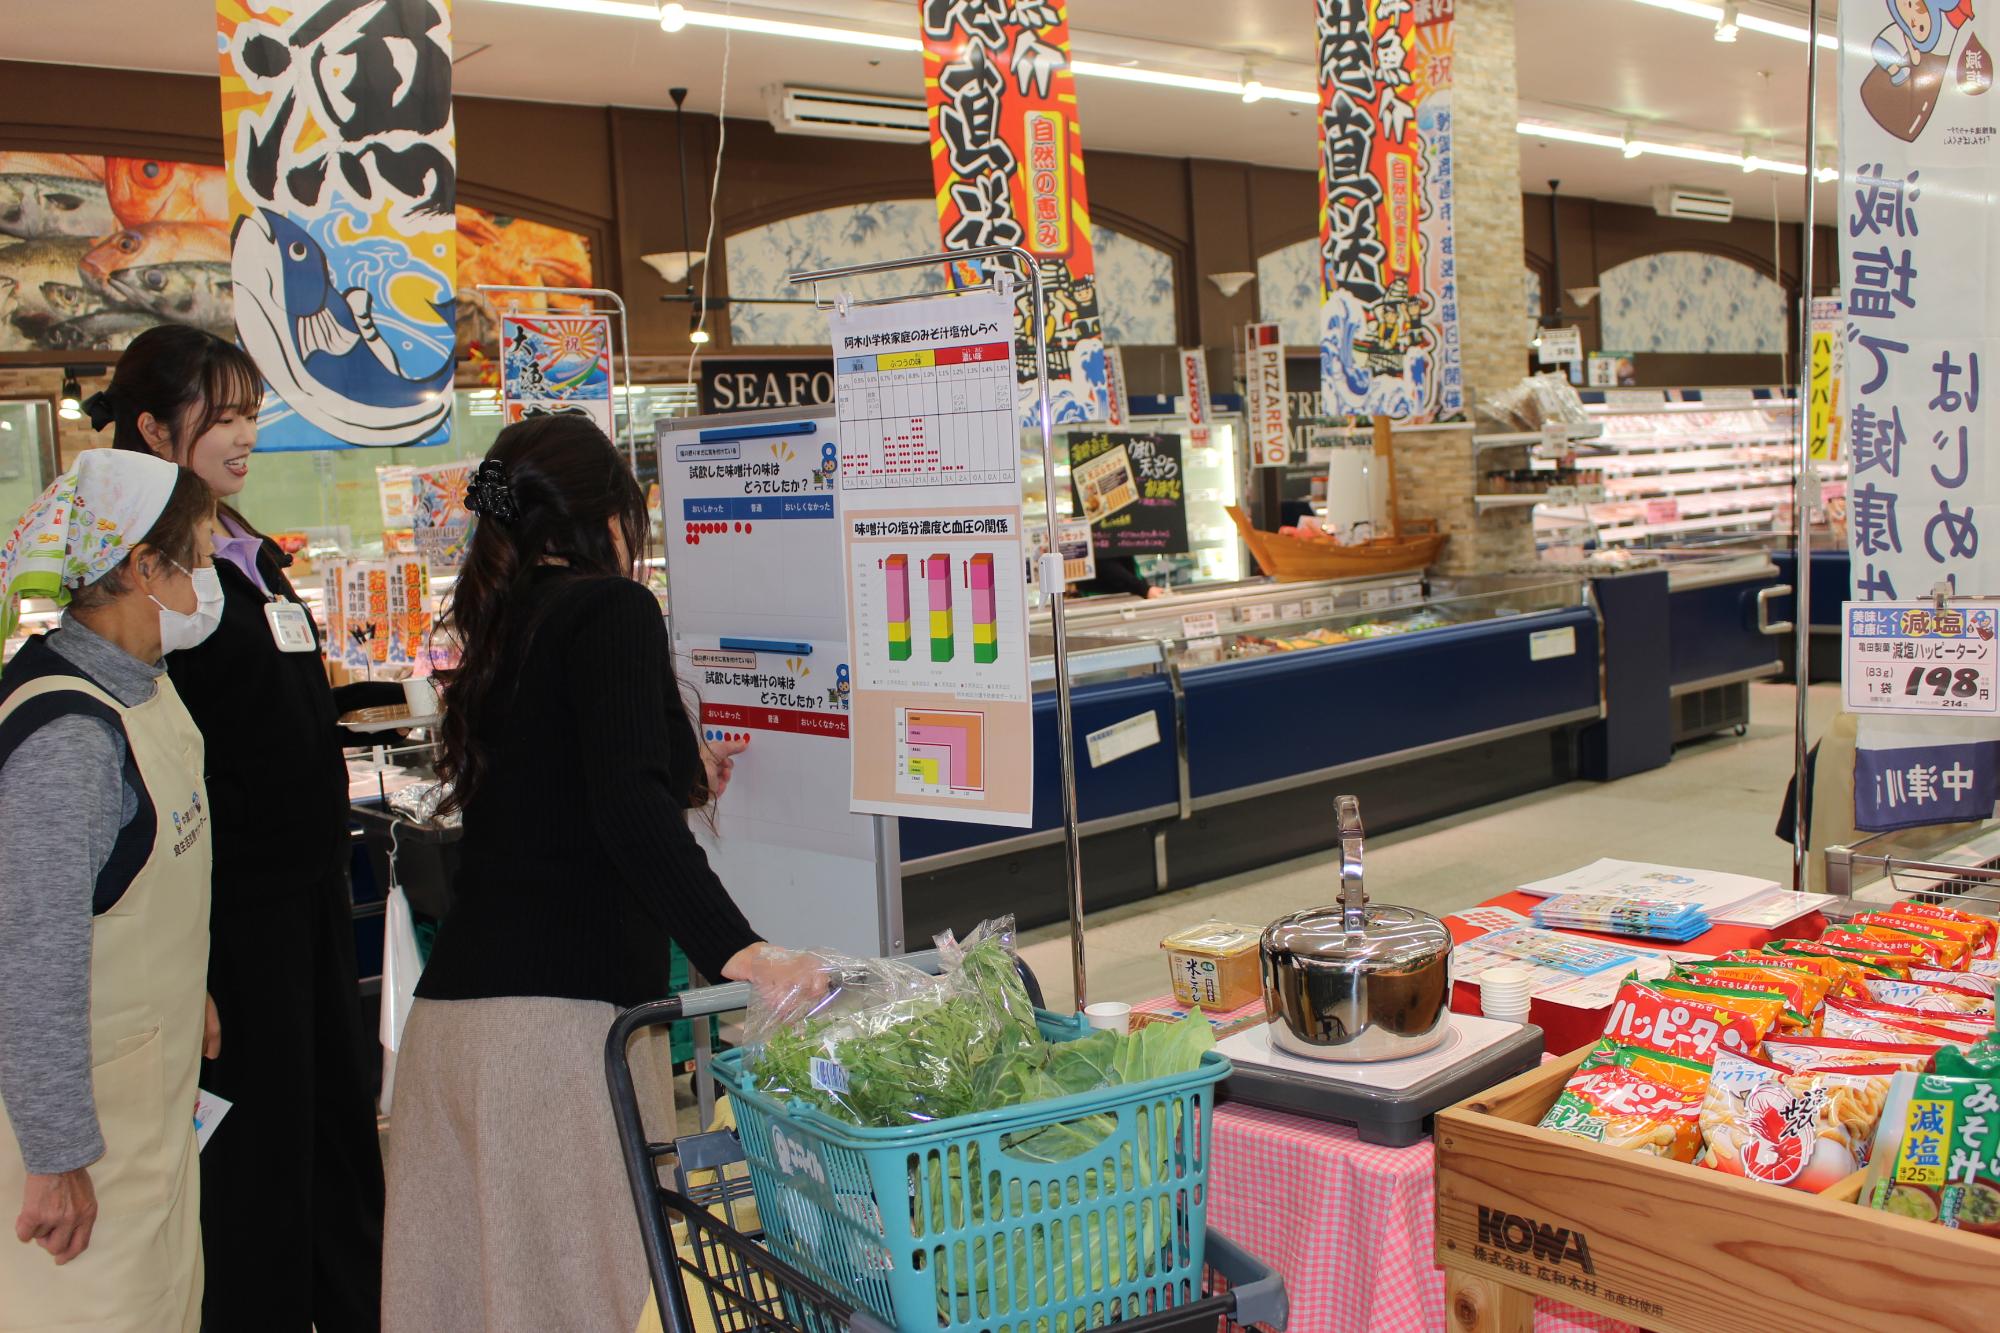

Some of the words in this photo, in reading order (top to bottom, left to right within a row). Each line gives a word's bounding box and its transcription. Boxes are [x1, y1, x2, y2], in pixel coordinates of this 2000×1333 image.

[1427, 56, 1453, 87] 祝
[1031, 116, 1060, 247] 自然の恵み
[565, 337, 580, 351] 祝
[844, 322, 999, 349] 阿木小学校家庭のみそ汁塩分しらべ
[713, 371, 834, 409] SEAFO
[1810, 339, 1831, 455] ハンバーグ
[1262, 351, 1285, 462] PIZZAREVO
[689, 462, 780, 479] 試飲した味噌汁の味は
[1140, 455, 1178, 479] 天ぷら
[744, 479, 808, 494] どうでしたか？
[692, 504, 724, 513] おいしかった
[751, 503, 762, 513] 普通
[784, 502, 831, 511] おいしくなかった
[855, 519, 1008, 536] 味噌汁の塩分濃度と血圧の関係
[1852, 610, 1898, 623] 美味しく
[1901, 611, 1962, 634] 減塩
[1853, 623, 1896, 636] 健康に！
[1892, 642, 1988, 660] 減塩ハッピーターン
[705, 671, 796, 690] 試飲した味噌汁の味は
[1865, 666, 1894, 678] (83g)
[1905, 666, 1979, 698] 198
[1980, 689, 1989, 700] 円
[760, 692, 823, 708] どうでしたか？
[708, 710, 741, 720] おいしかった
[801, 719, 846, 730] おいしくなかった
[1705, 977, 1765, 991] ツイてるしあわせ
[1711, 1070, 1767, 1082] ノンフライ
[1905, 1102, 1945, 1166] 減塩
[1949, 1083, 2000, 1185] みそ汁
[1907, 1167, 1927, 1181] 25
[1477, 1204, 1597, 1276] KOWA
[1473, 1245, 1532, 1276] 株式会社
[1536, 1266, 1599, 1297] 広和木材
